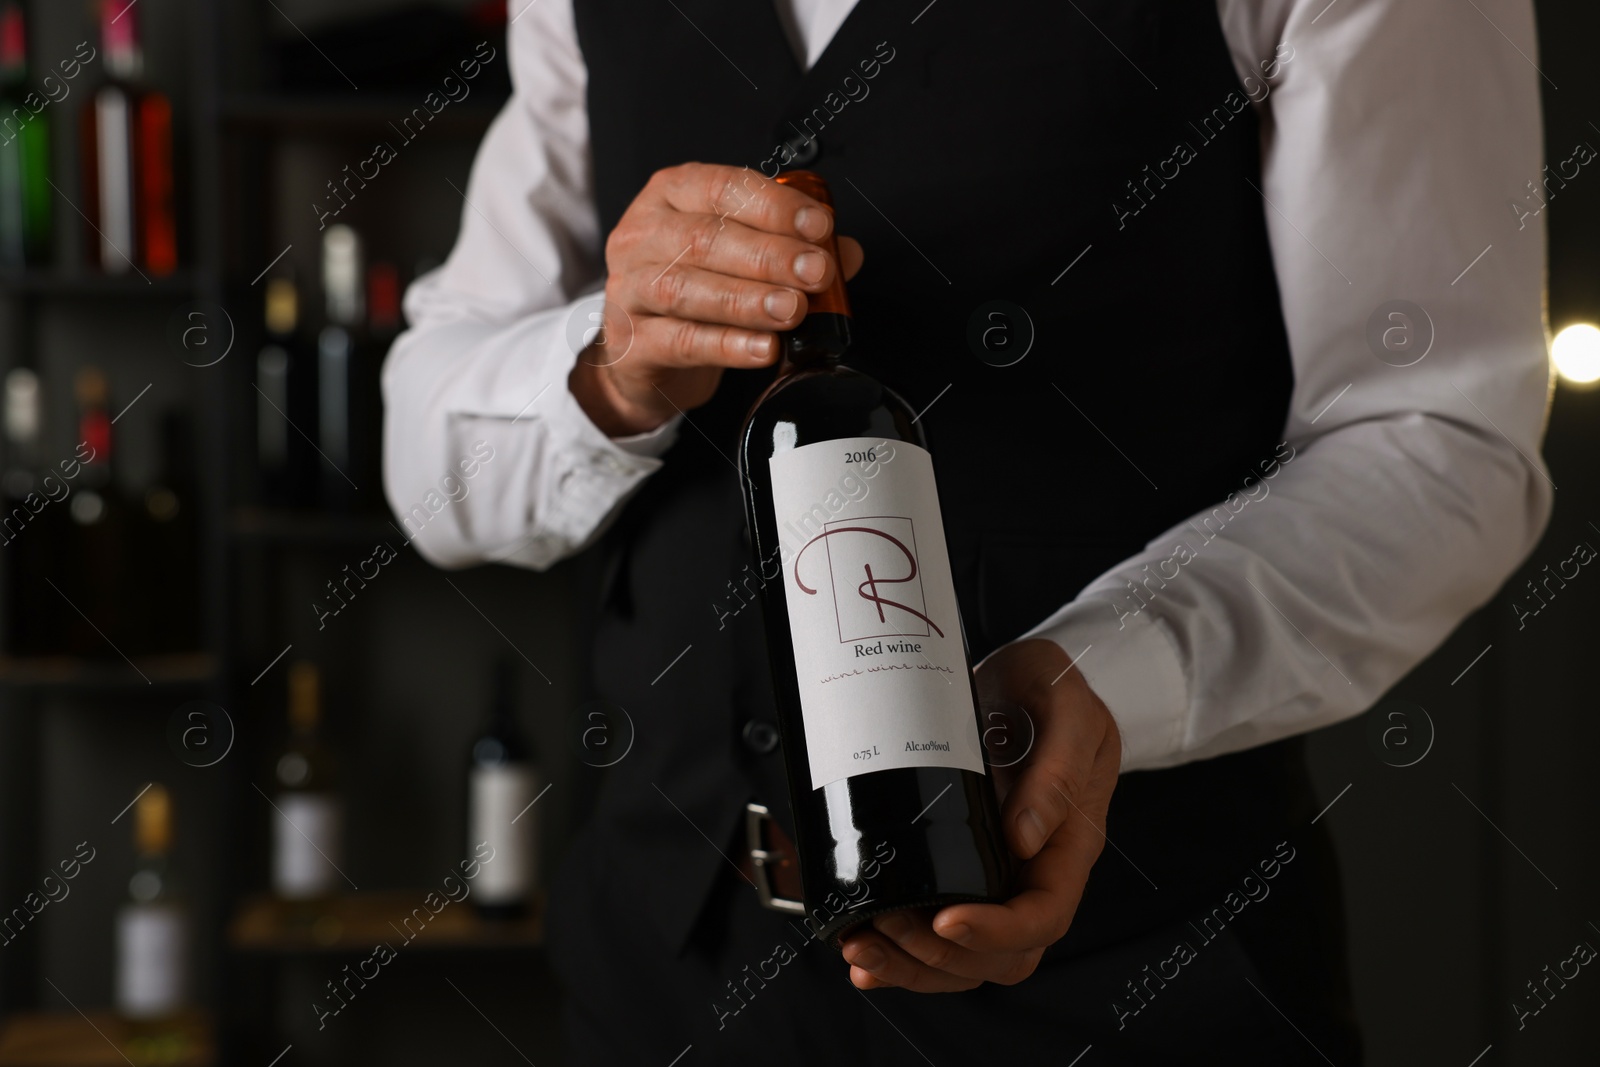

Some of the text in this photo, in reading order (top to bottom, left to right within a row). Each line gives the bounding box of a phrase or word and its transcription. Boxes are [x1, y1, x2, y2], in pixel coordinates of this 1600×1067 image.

[844, 447, 876, 463] 2016
[794, 526, 944, 638] R
[854, 640, 922, 658] Red wine
[853, 745, 880, 760] 0.75 L
[904, 740, 950, 752] Alc.10%vol
